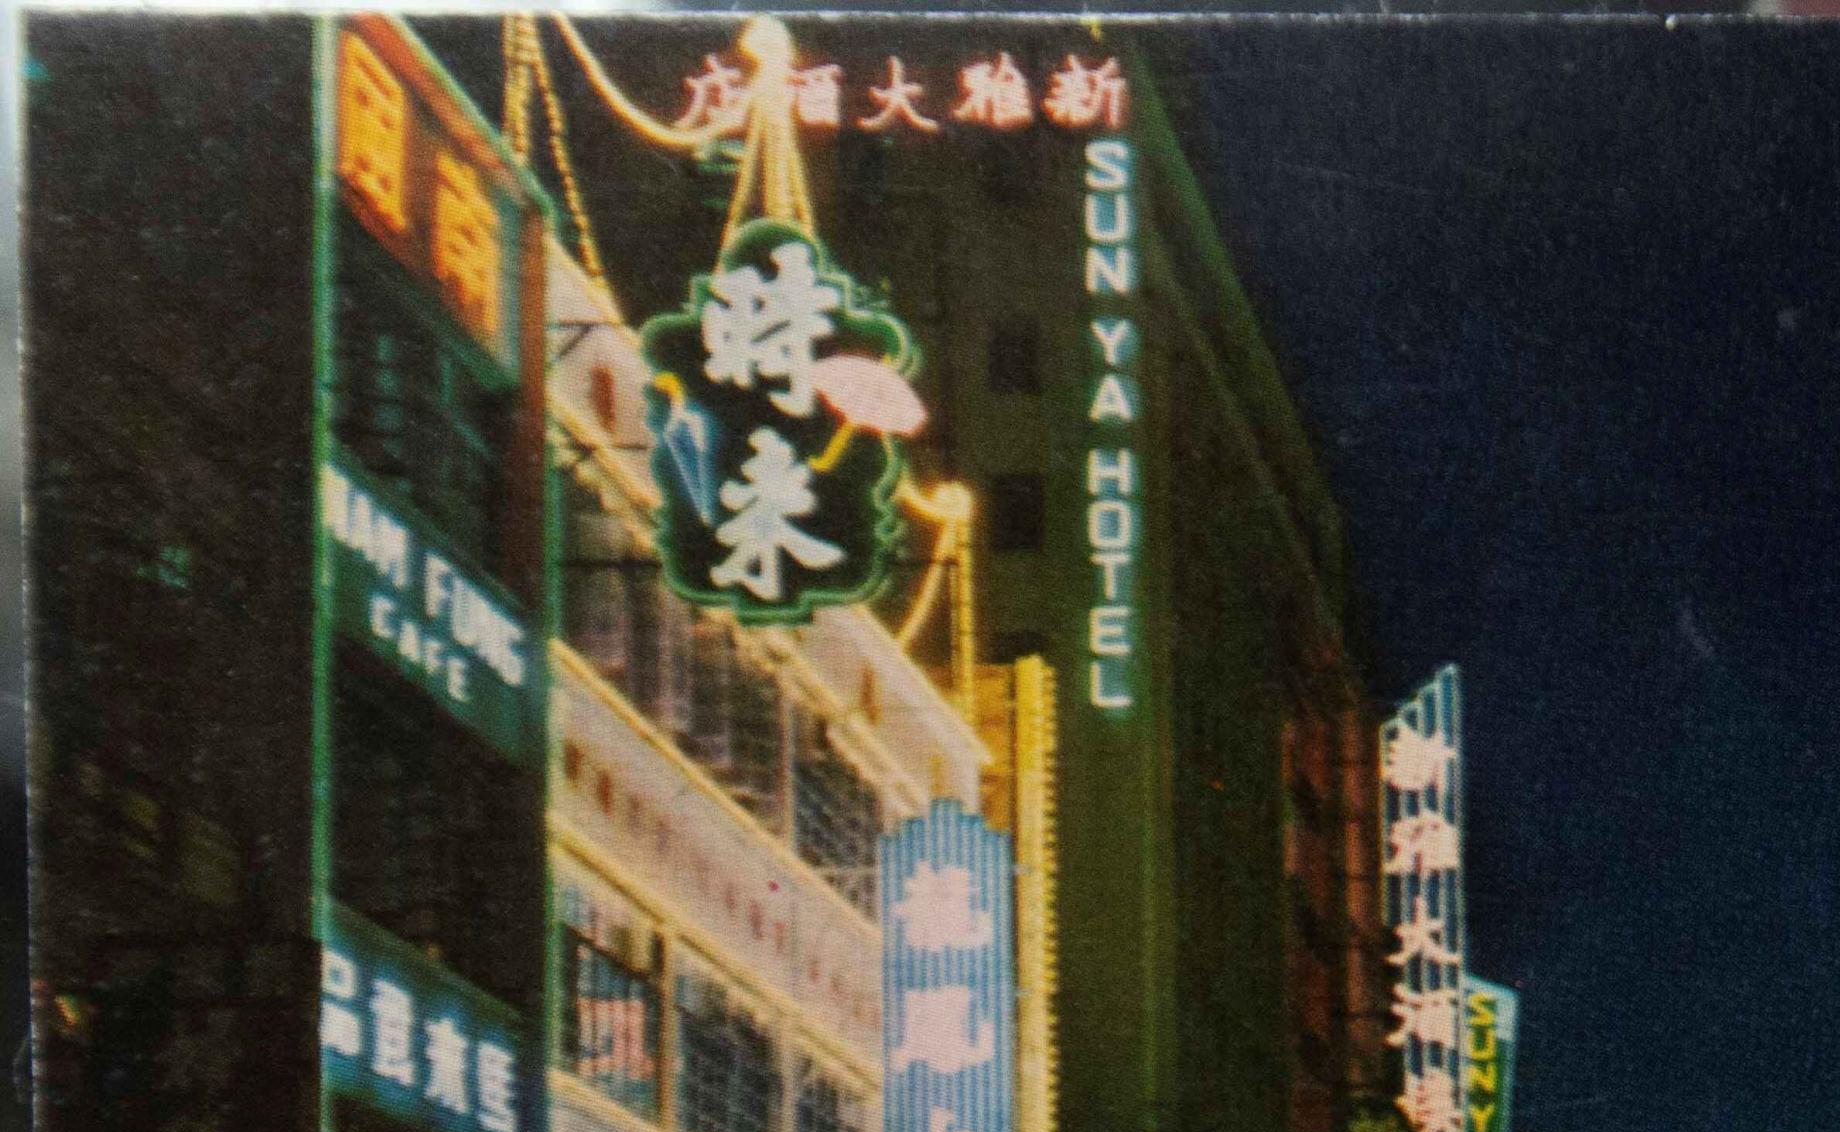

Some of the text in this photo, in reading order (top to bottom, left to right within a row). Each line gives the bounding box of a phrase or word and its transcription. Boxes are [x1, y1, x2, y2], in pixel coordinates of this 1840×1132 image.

[1084, 140, 1132, 707] SUN YA HOTEL
[370, 593, 468, 700] CAFE
[1468, 993, 1498, 1090] SUN
